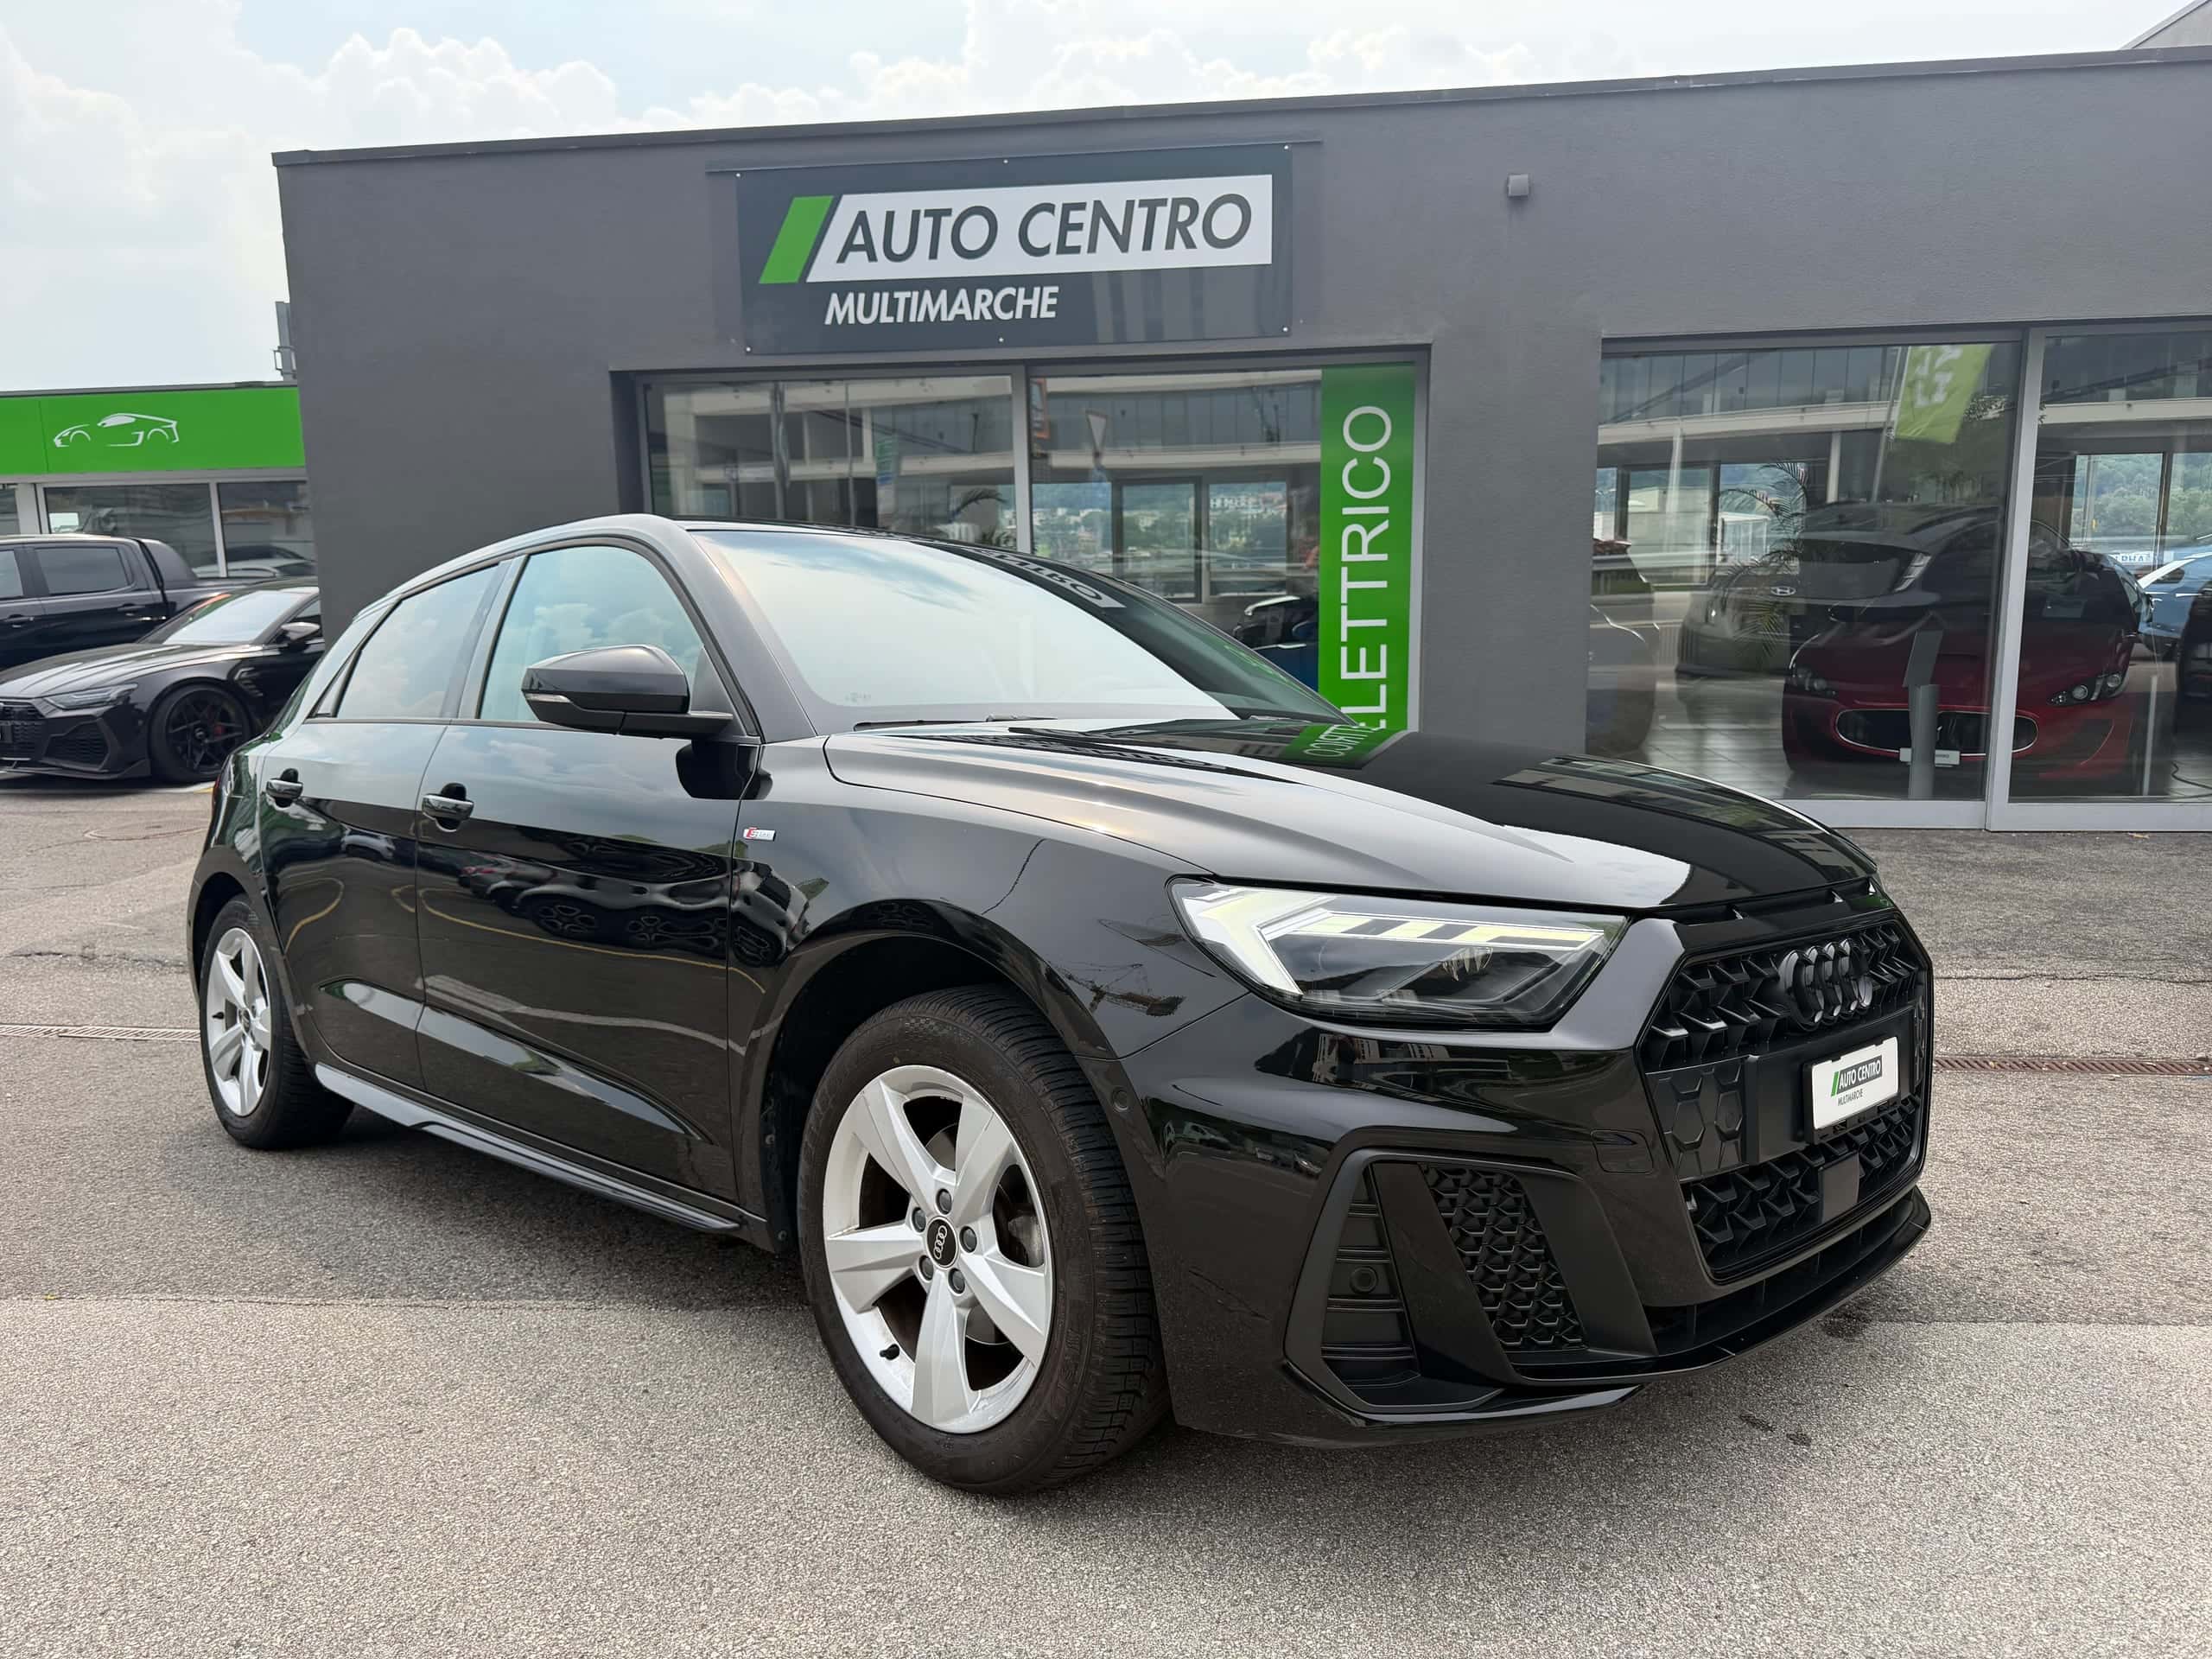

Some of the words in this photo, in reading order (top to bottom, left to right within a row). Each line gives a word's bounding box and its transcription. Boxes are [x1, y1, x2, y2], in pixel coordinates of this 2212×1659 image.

[836, 205, 999, 264] AUTO
[1018, 193, 1252, 257] CENTRO
[823, 286, 1059, 326] MULTIMARCHE
[1840, 1070, 1856, 1088] AUTO
[1858, 1060, 1881, 1081] CENTRO
